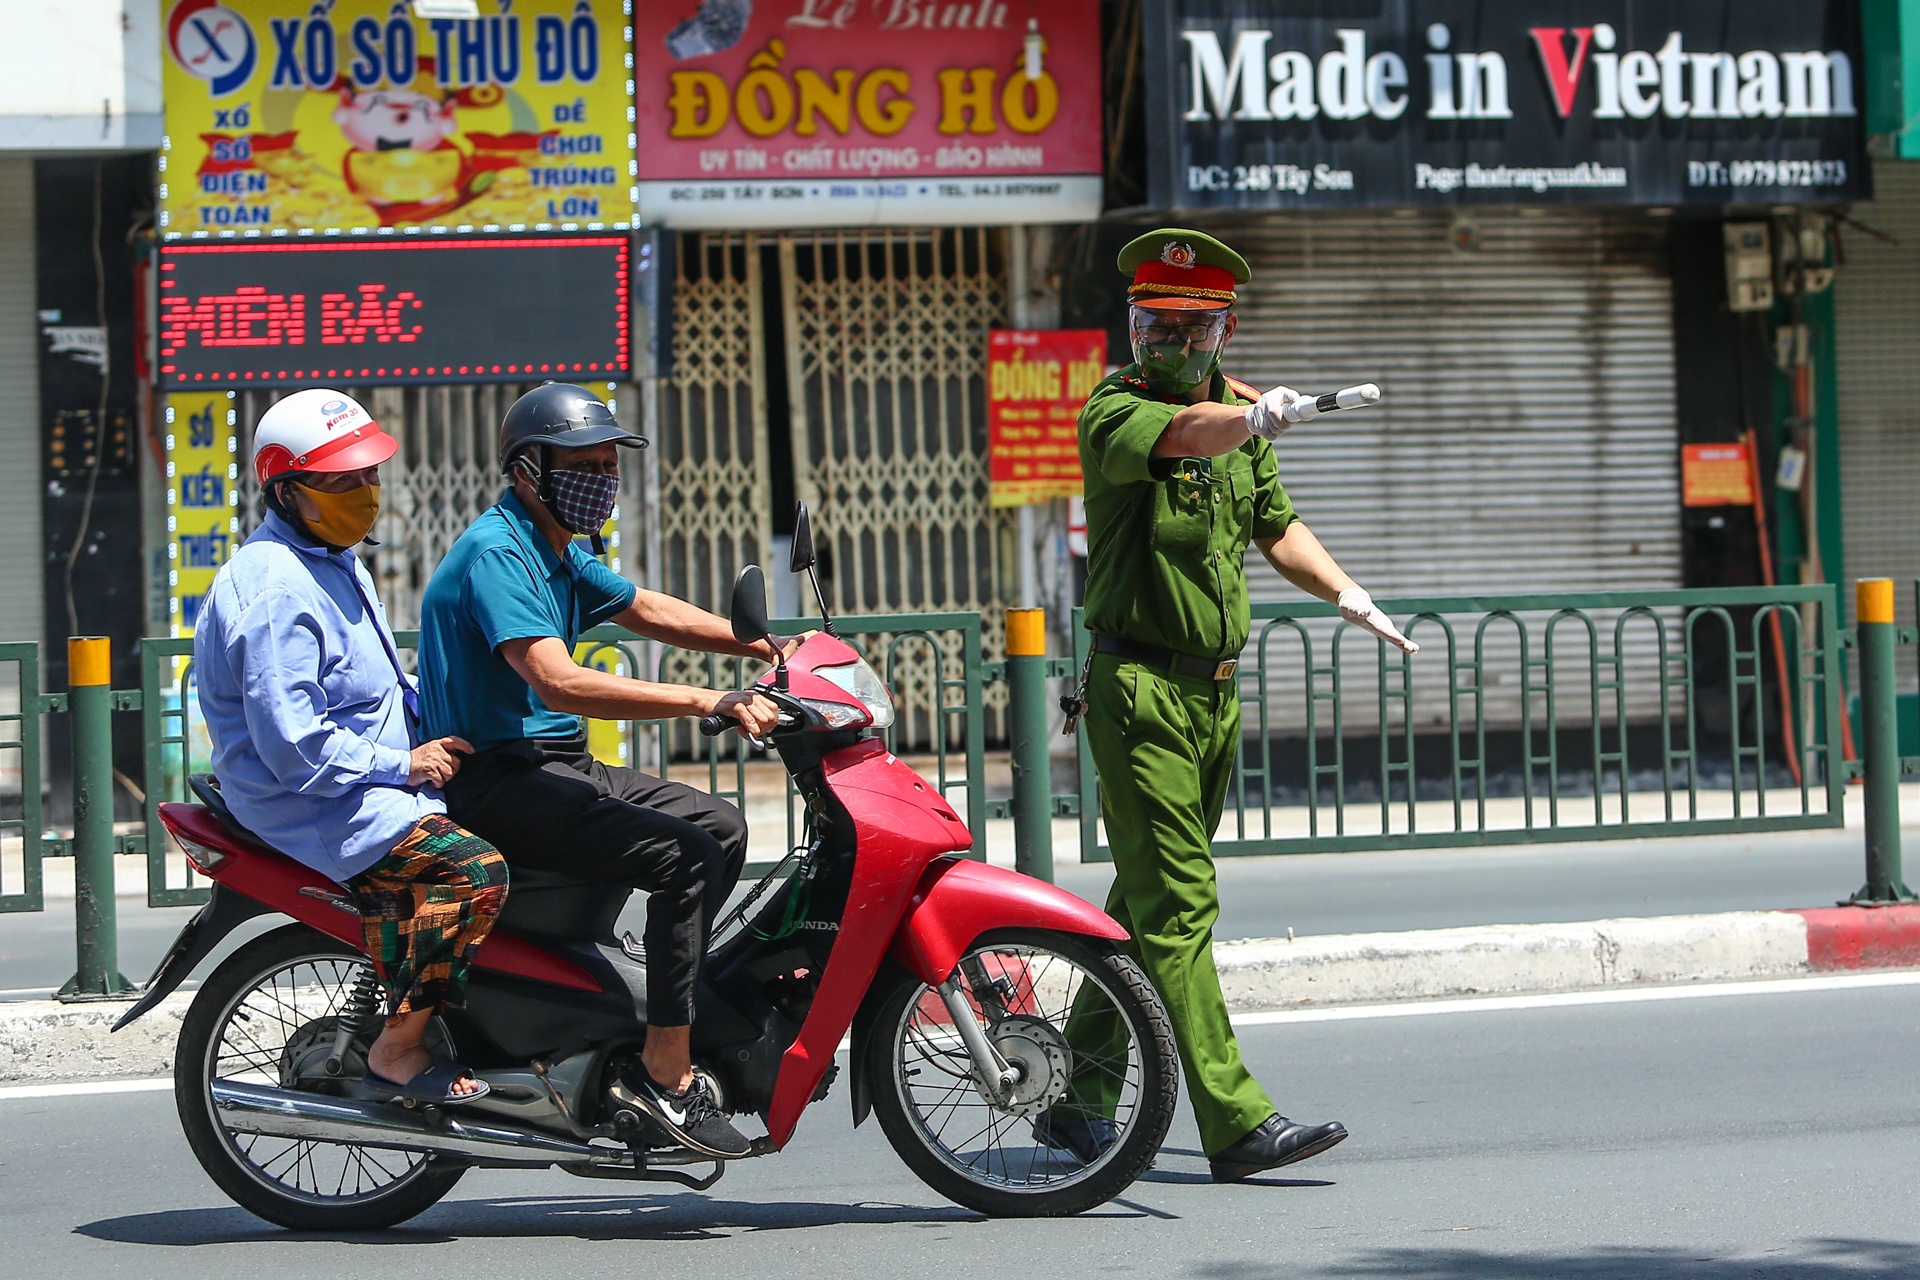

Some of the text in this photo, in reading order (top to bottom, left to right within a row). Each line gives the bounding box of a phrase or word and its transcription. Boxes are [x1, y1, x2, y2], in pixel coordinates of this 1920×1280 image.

[535, 1, 599, 84] ĐÔ
[668, 38, 914, 138] ĐỒNG
[1181, 22, 1858, 121] Made in Vietnam
[1233, 164, 1271, 191] 248
